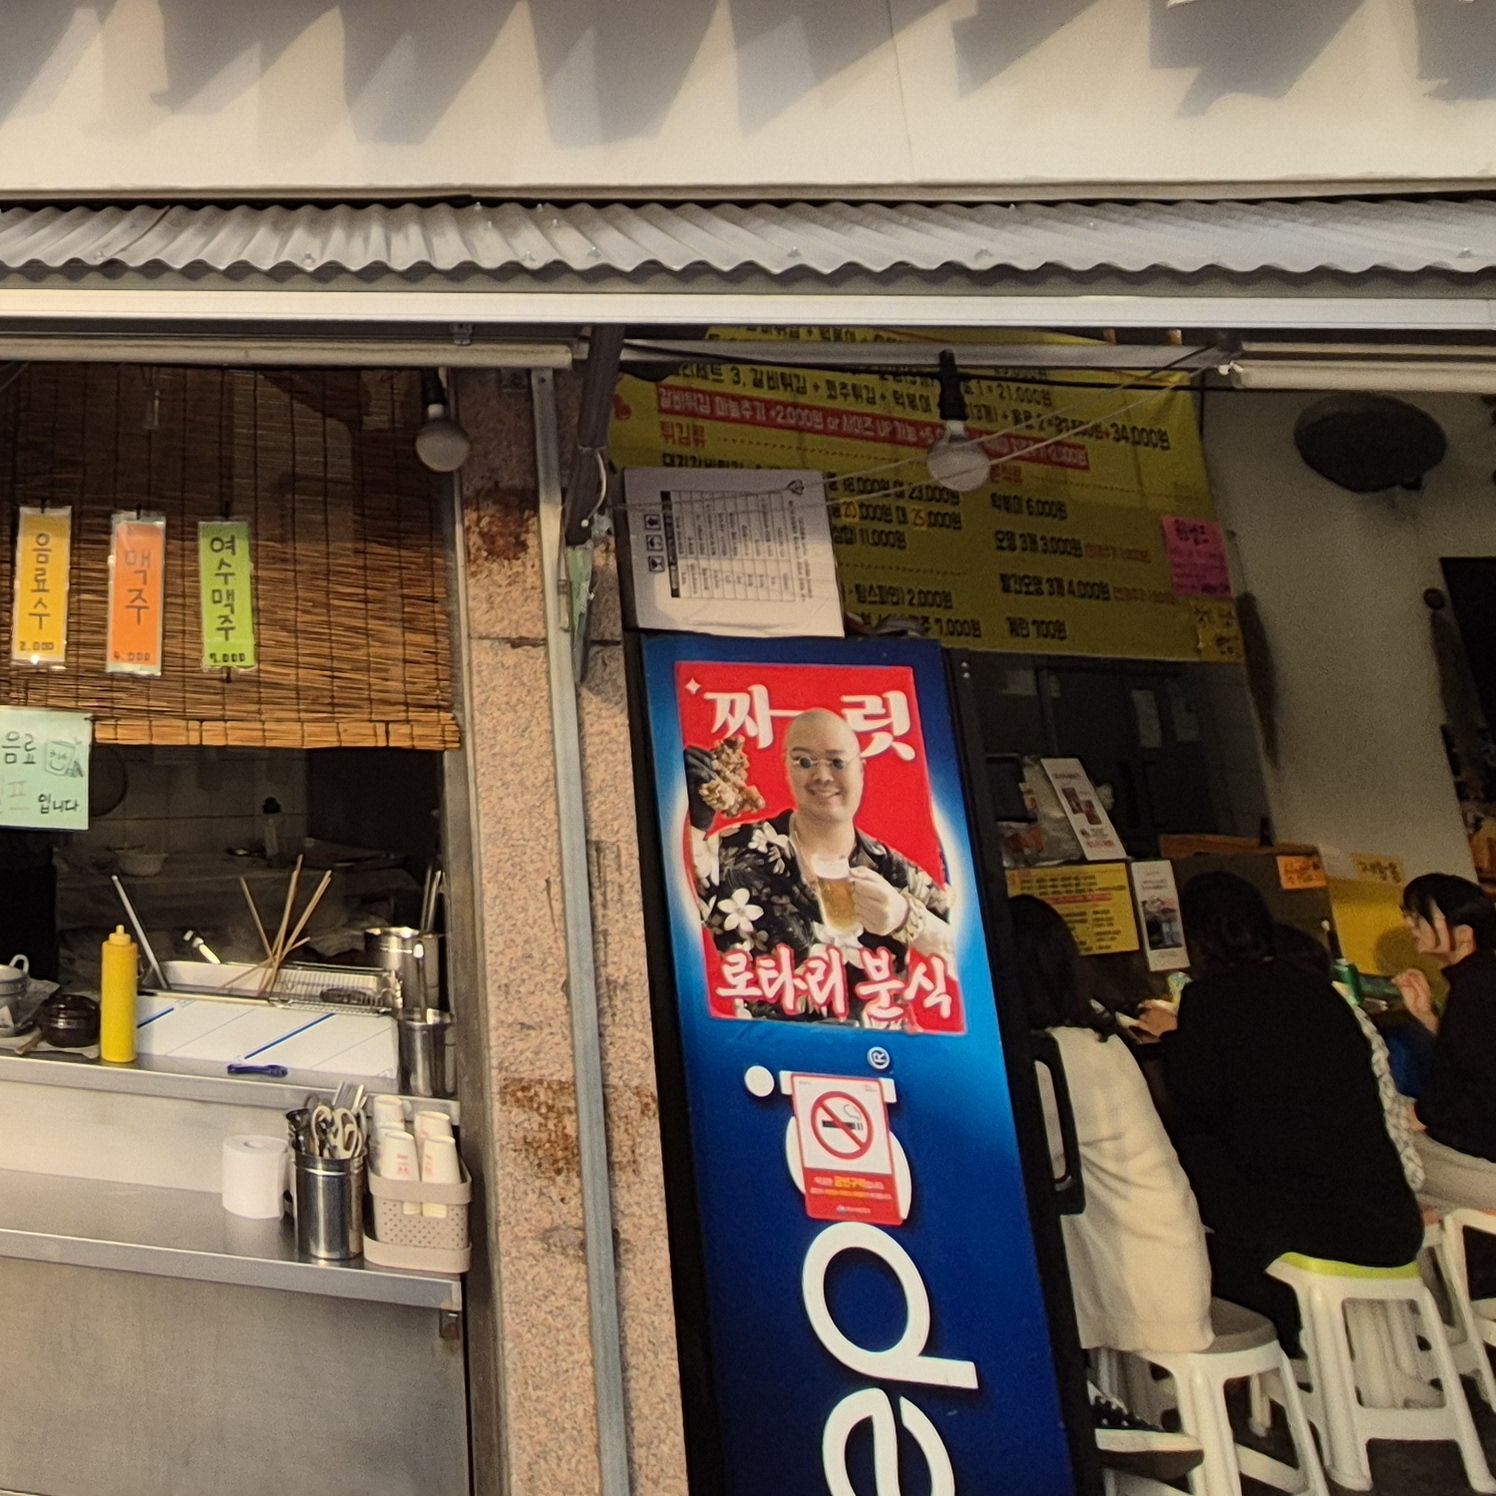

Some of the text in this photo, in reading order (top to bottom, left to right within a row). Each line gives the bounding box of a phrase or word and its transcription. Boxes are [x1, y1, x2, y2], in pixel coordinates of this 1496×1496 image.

[28, 532, 53, 631] 음료수
[123, 548, 152, 626] 맥주
[209, 534, 237, 642] 여수맥주
[2, 730, 37, 765] 음료
[38, 793, 81, 815] 입니다
[716, 943, 955, 1020] 로타리 분식
